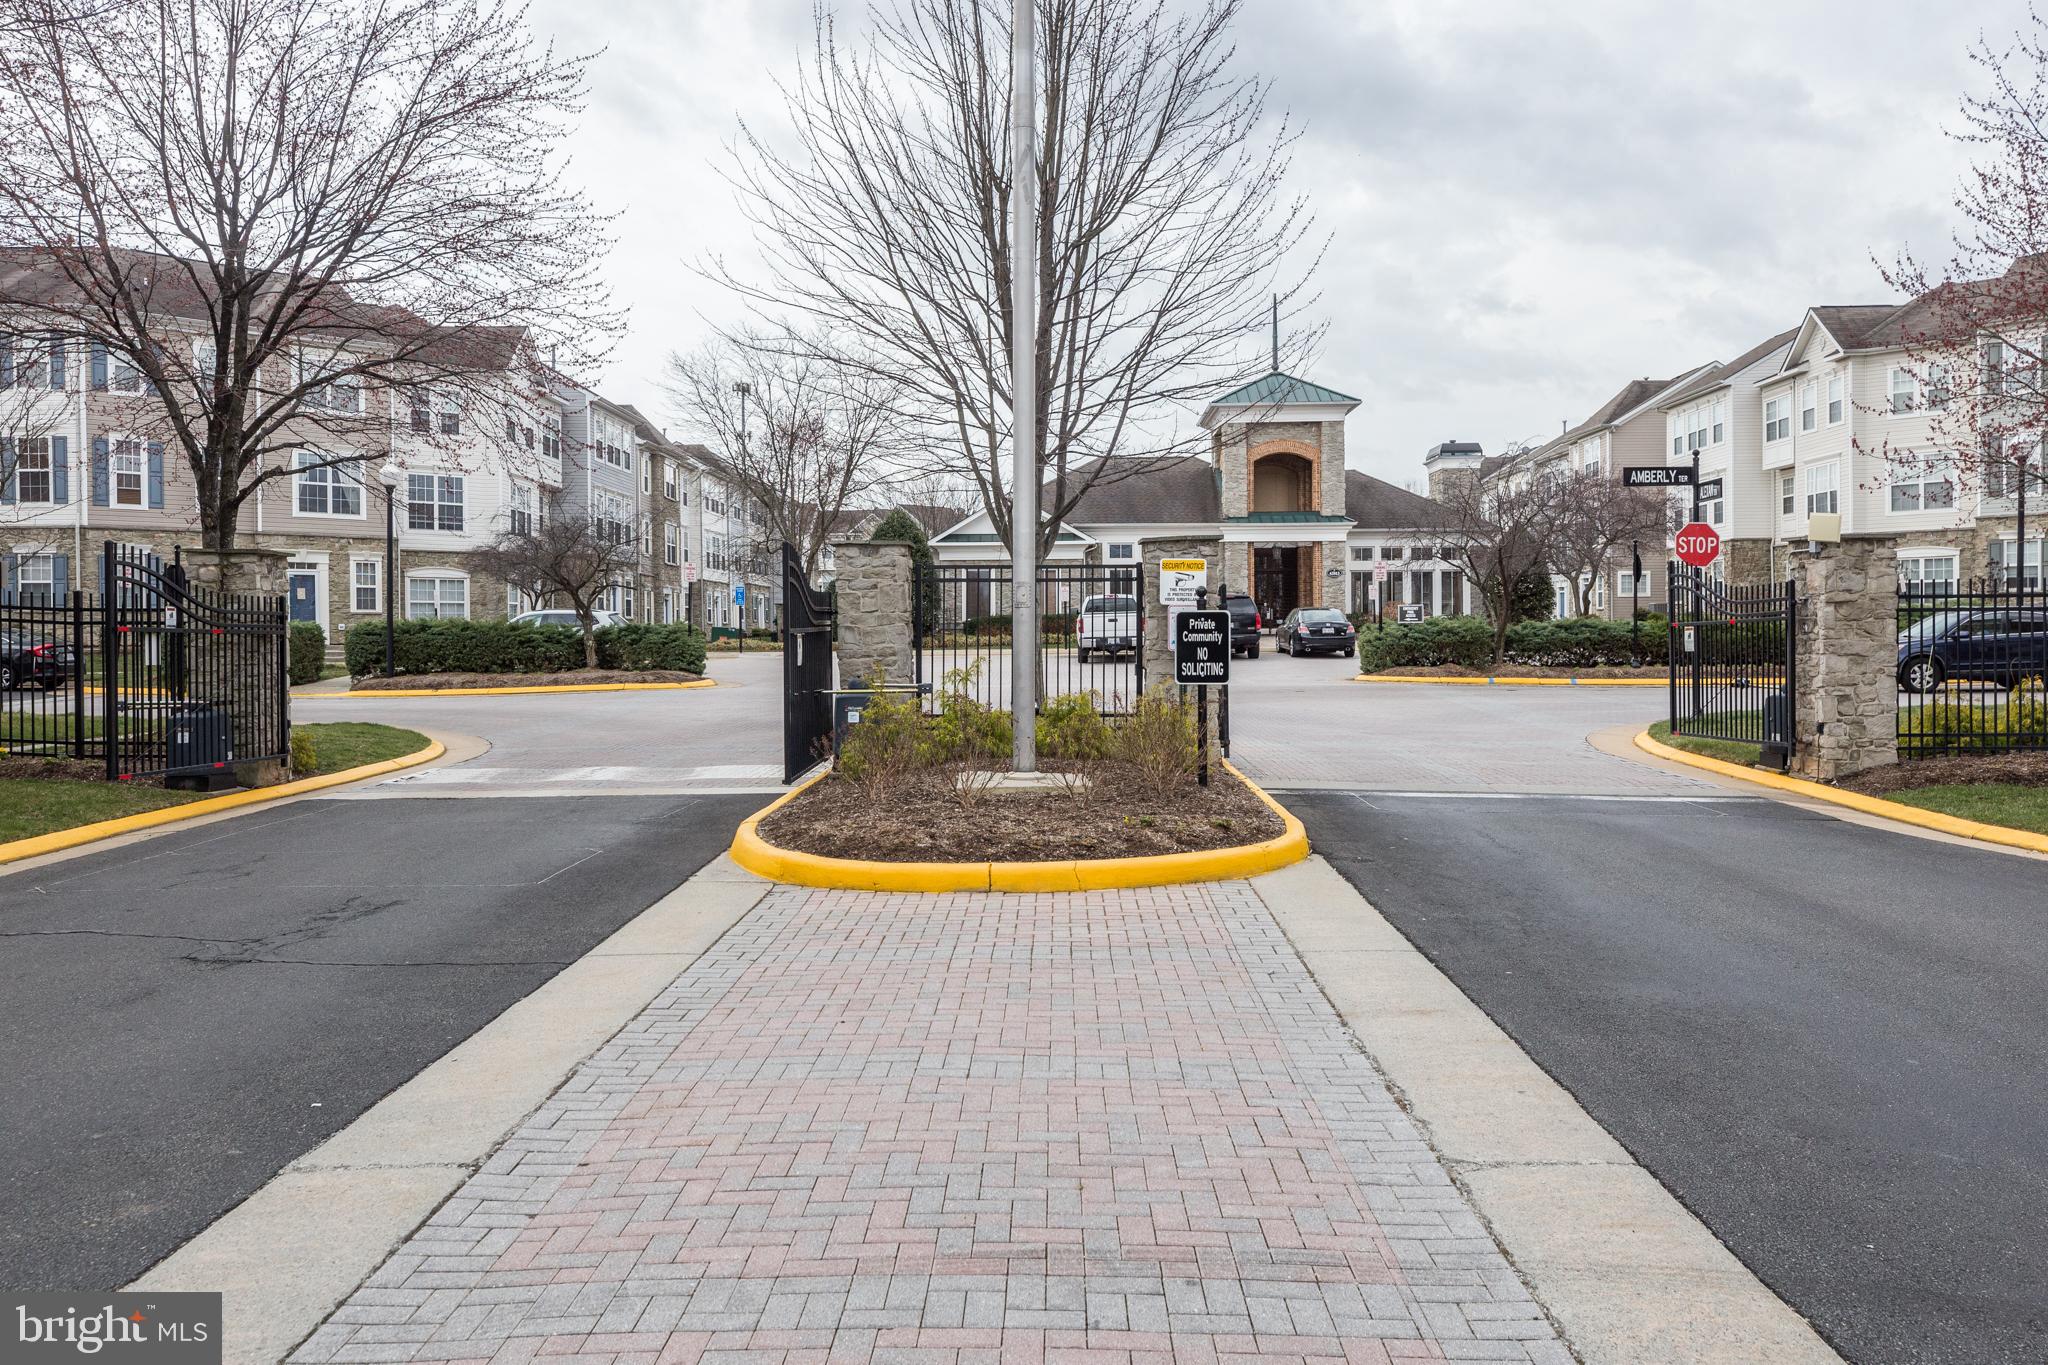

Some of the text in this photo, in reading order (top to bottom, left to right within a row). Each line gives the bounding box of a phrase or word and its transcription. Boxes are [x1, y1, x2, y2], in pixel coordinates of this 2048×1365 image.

[1630, 469, 1689, 484] AMBERLY TER
[1678, 536, 1717, 554] STOP
[1162, 562, 1205, 570] SECURITY NOTICE
[1189, 618, 1216, 630] Private
[1182, 631, 1223, 645] Community
[1197, 647, 1209, 661] NO
[1181, 662, 1224, 676] SOLICITING
